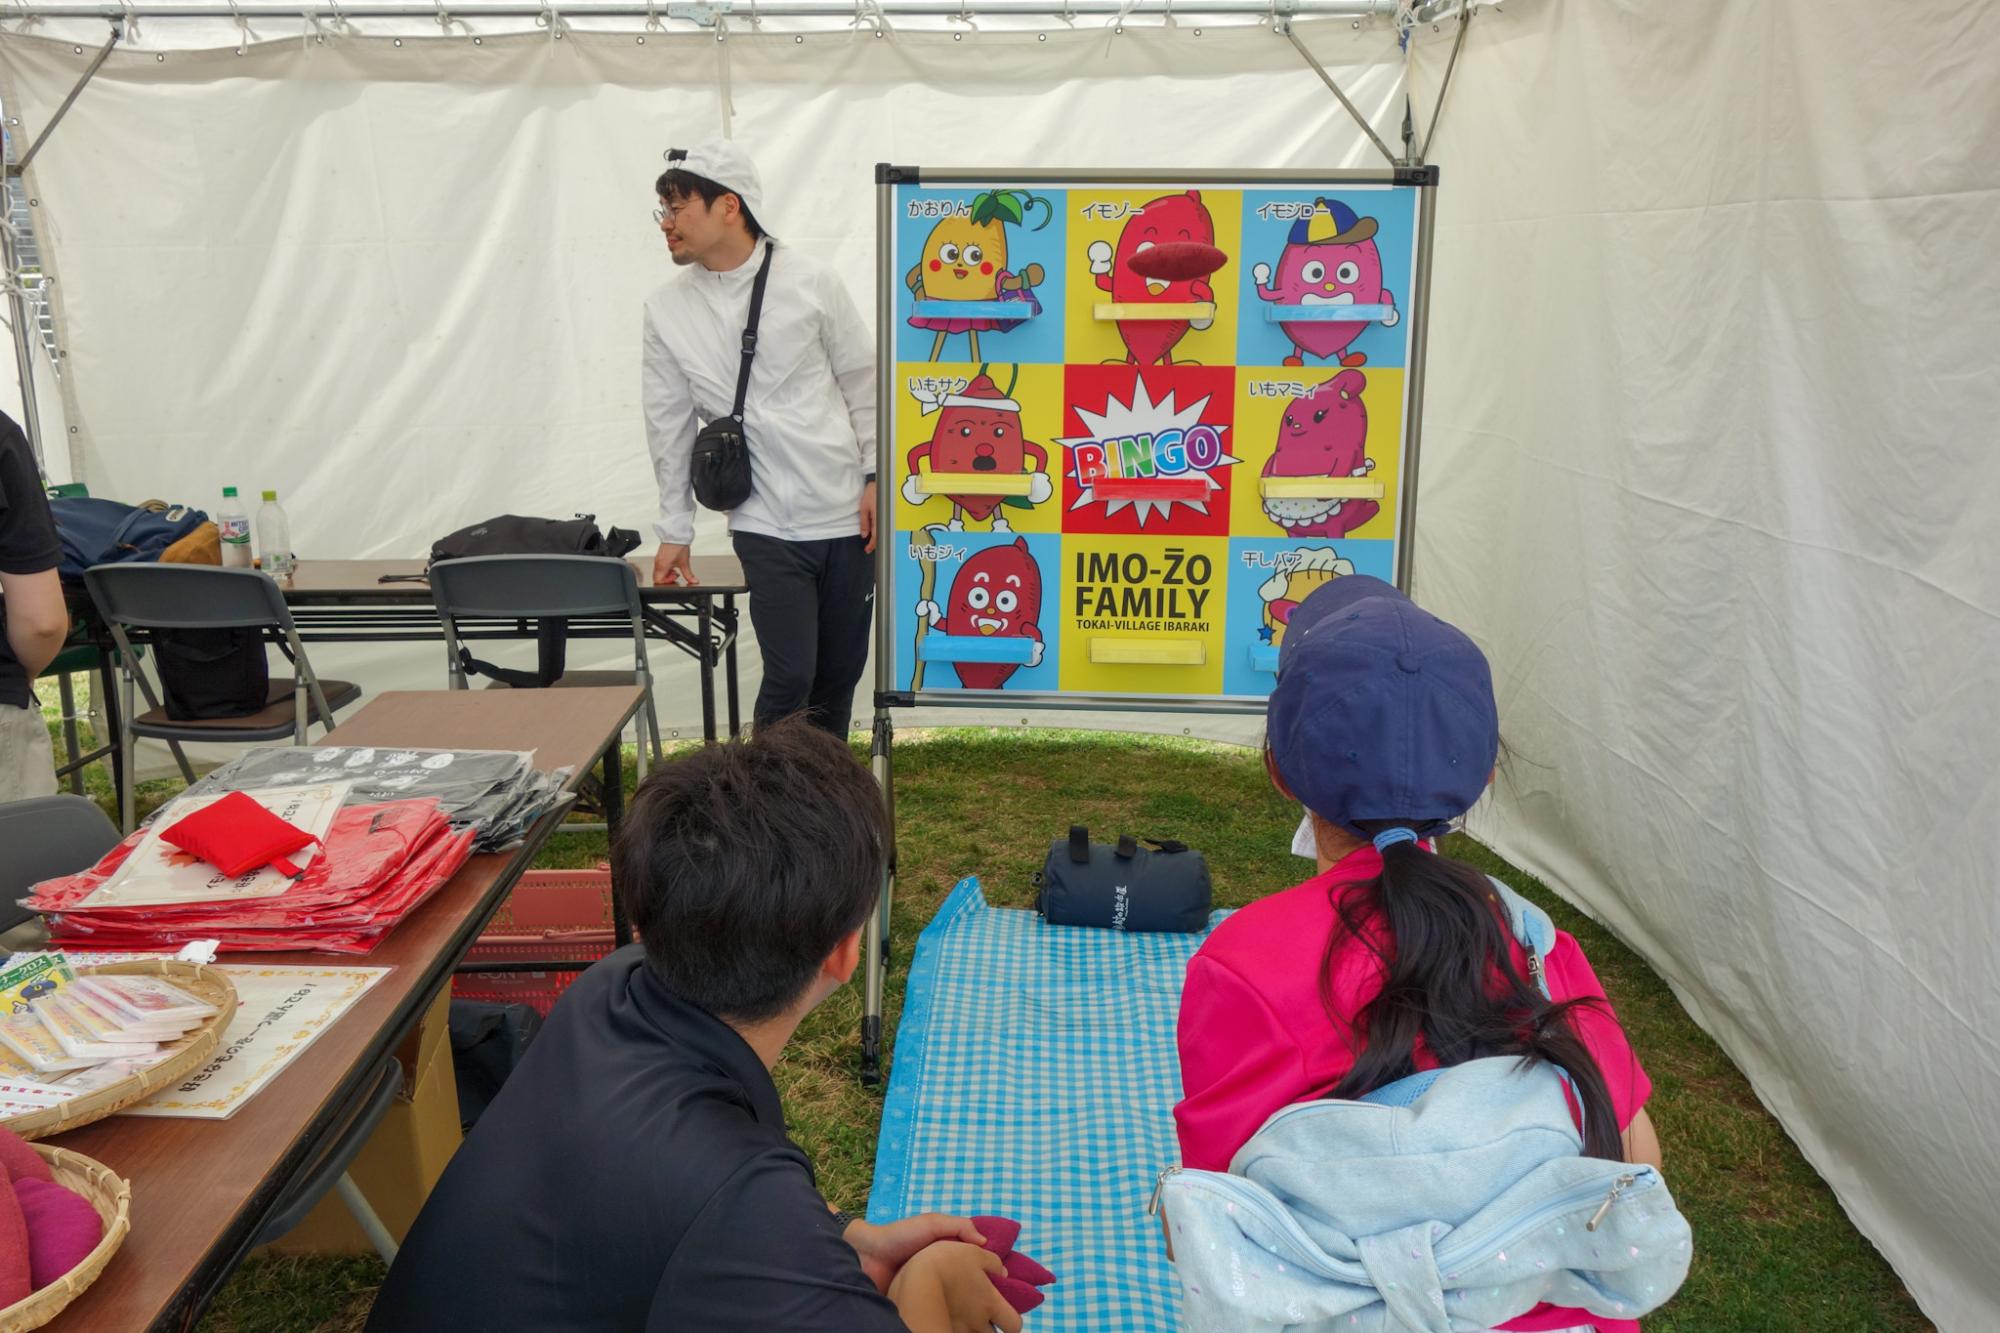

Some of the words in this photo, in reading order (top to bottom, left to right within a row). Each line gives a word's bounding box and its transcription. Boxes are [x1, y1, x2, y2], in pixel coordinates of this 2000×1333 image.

[908, 200, 971, 218] かおりん
[1082, 202, 1144, 219] イモゾー
[1256, 203, 1329, 219] イモジロー
[908, 377, 968, 393] いもサク
[1249, 381, 1317, 399] いもマミィ
[1073, 424, 1221, 488] BINGO
[1075, 586, 1210, 619] FAMILY
[1076, 619, 1161, 631] TOKAI-VILLAGE
[1163, 621, 1209, 632] IBARAKI
